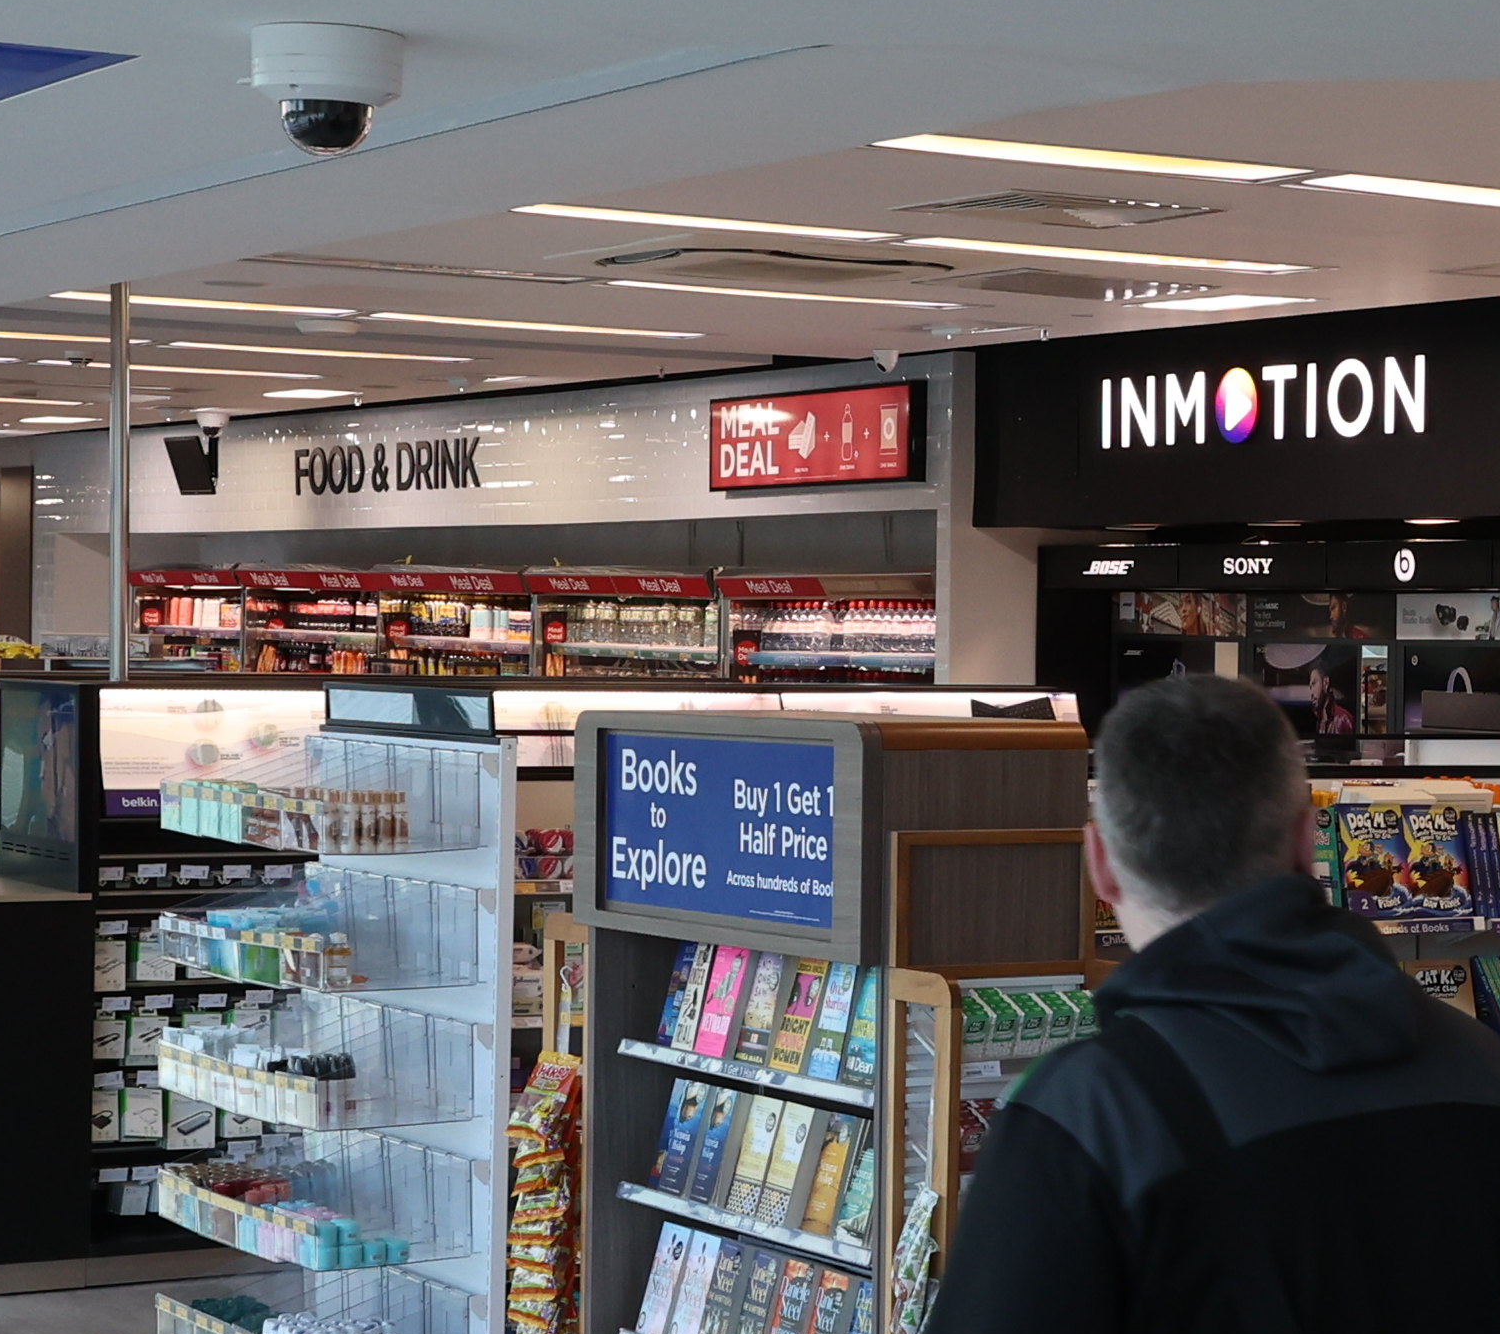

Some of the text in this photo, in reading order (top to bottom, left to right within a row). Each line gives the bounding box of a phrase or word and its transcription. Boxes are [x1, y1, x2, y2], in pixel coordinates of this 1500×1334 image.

[1101, 353, 1426, 450] INMOTION
[719, 402, 780, 440] MEAL
[294, 437, 482, 496] FOOD & DRINK
[719, 443, 780, 478] DEAL
[319, 573, 361, 589] Meal Deal
[1082, 560, 1135, 575] BOSE
[1223, 558, 1273, 575] SONY
[745, 580, 793, 594] Meal Deal
[621, 748, 698, 795] Books
[121, 796, 158, 808] belkin
[734, 779, 834, 818] Buy 1 Get 1
[650, 802, 667, 828] to
[739, 822, 828, 861] Half Price
[612, 836, 707, 890] Explore
[726, 870, 755, 889] Across
[756, 874, 798, 894] hundreds
[800, 877, 811, 894] of
[780, 1017, 809, 1034] BRIGHT
